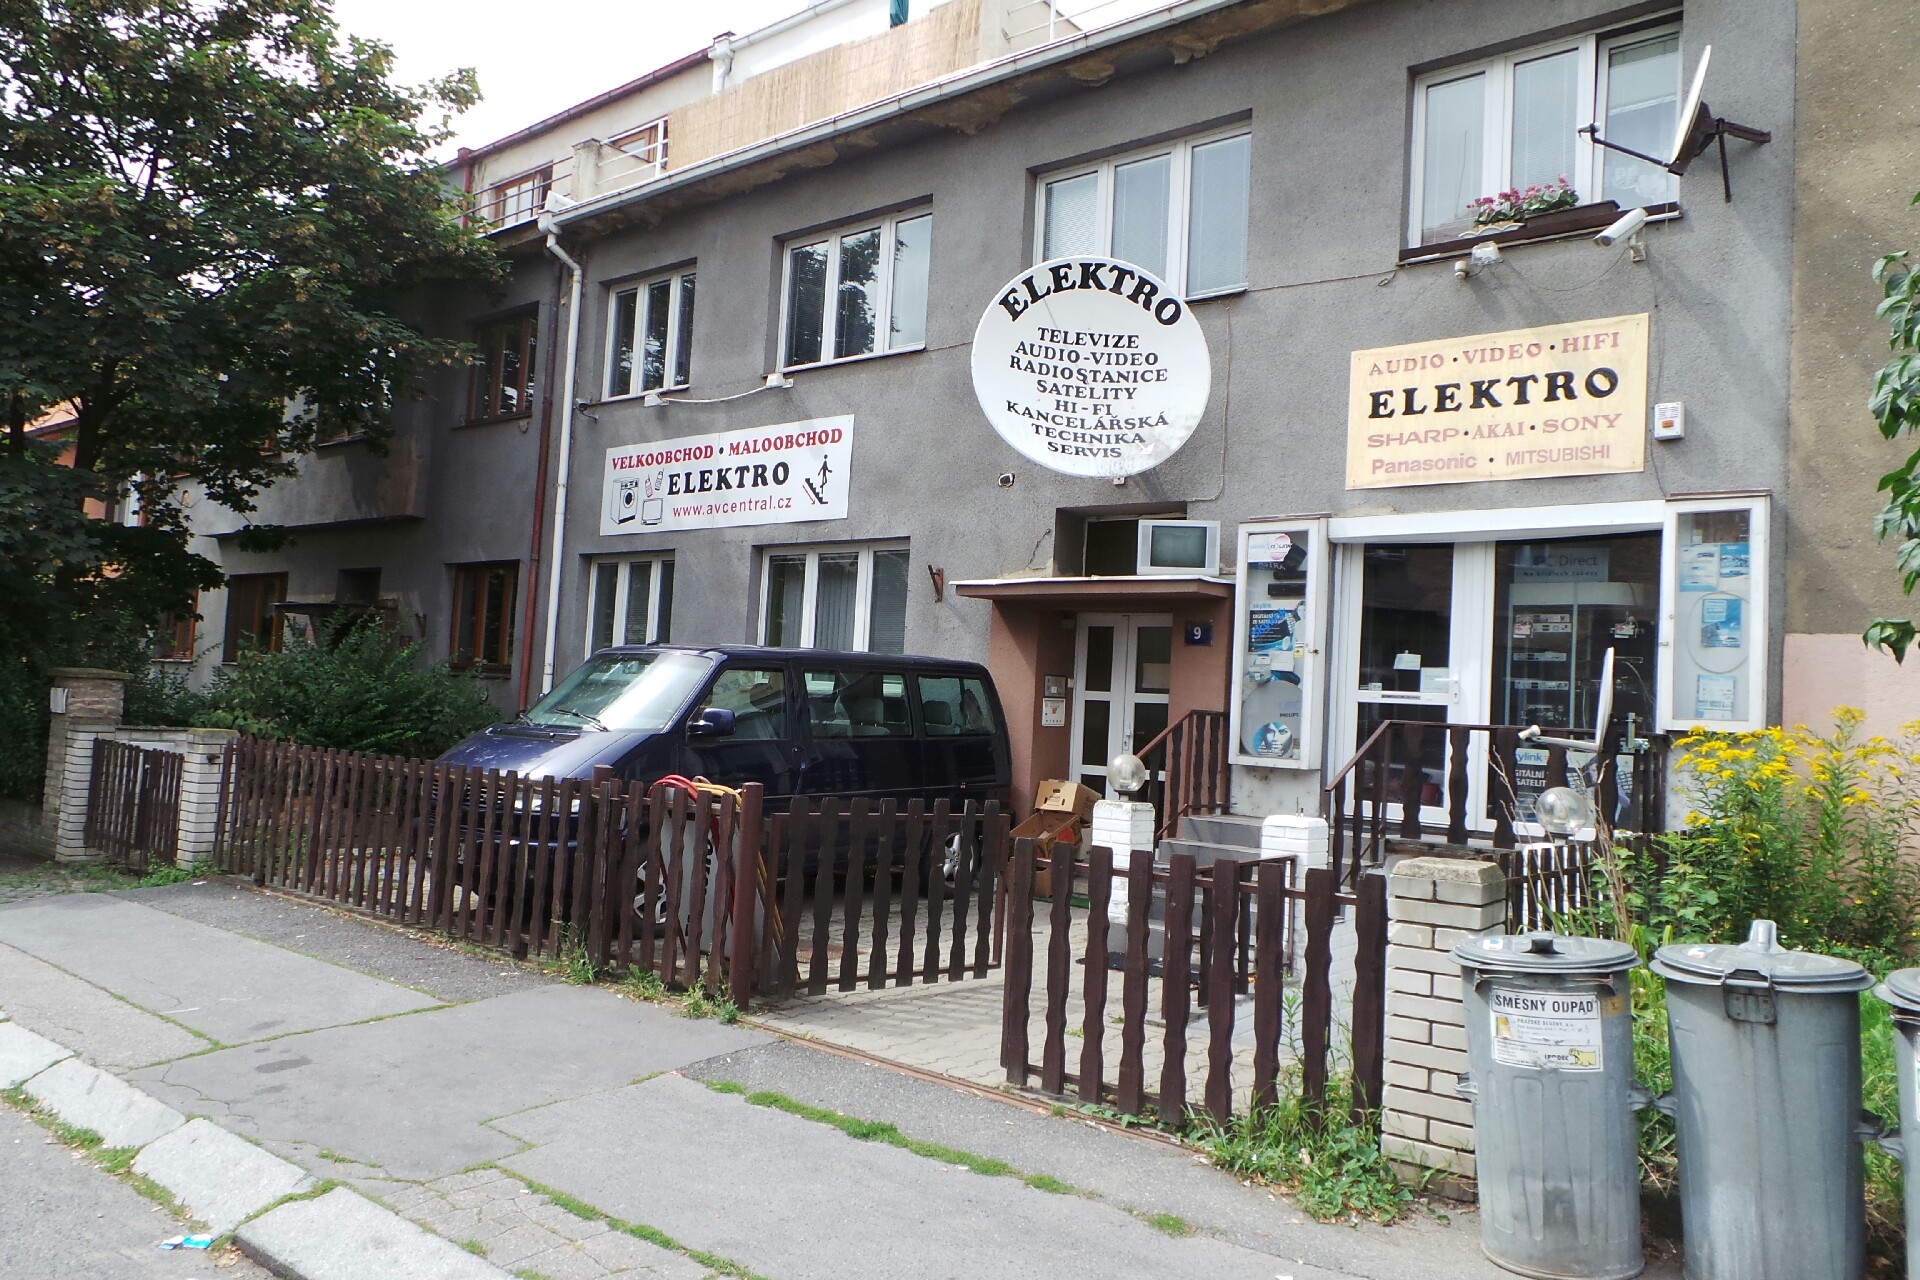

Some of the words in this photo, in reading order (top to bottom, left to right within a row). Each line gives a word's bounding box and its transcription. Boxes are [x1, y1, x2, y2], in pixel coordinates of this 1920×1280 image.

[998, 262, 1182, 326] ELEKTRO
[1037, 327, 1140, 349] TELEVIZE
[1014, 340, 1159, 367] AUDIO-VIDEO
[1369, 353, 1445, 376] AUDIO
[1463, 342, 1543, 365] VIDEO
[1561, 331, 1620, 354] HIFI
[1009, 354, 1169, 384] RADIOSTANICE
[1036, 379, 1138, 400] SATELITY
[1368, 367, 1620, 419] ELEKTRO
[1006, 400, 1170, 431] KANCELÁŘSKÁ
[1031, 423, 1146, 445] TECHNIKA
[1367, 427, 1461, 448] SHARP
[1471, 421, 1526, 440] AKAI
[1542, 413, 1623, 434] SONY
[612, 444, 715, 471] VELKOOBCHOD
[728, 428, 843, 457] MALOOBCHOD
[1047, 441, 1123, 458] SERVIS
[1371, 452, 1478, 475] Panasonic
[1505, 444, 1611, 467] MITSUBISHI
[667, 461, 791, 496] ELEKTRO
[672, 495, 792, 518] www.avcentral.cz
[1559, 555, 1600, 567] Direct
[1193, 626, 1202, 640] 9
[1516, 751, 1543, 763] ylink
[1552, 1001, 1594, 1013] ODPAD
